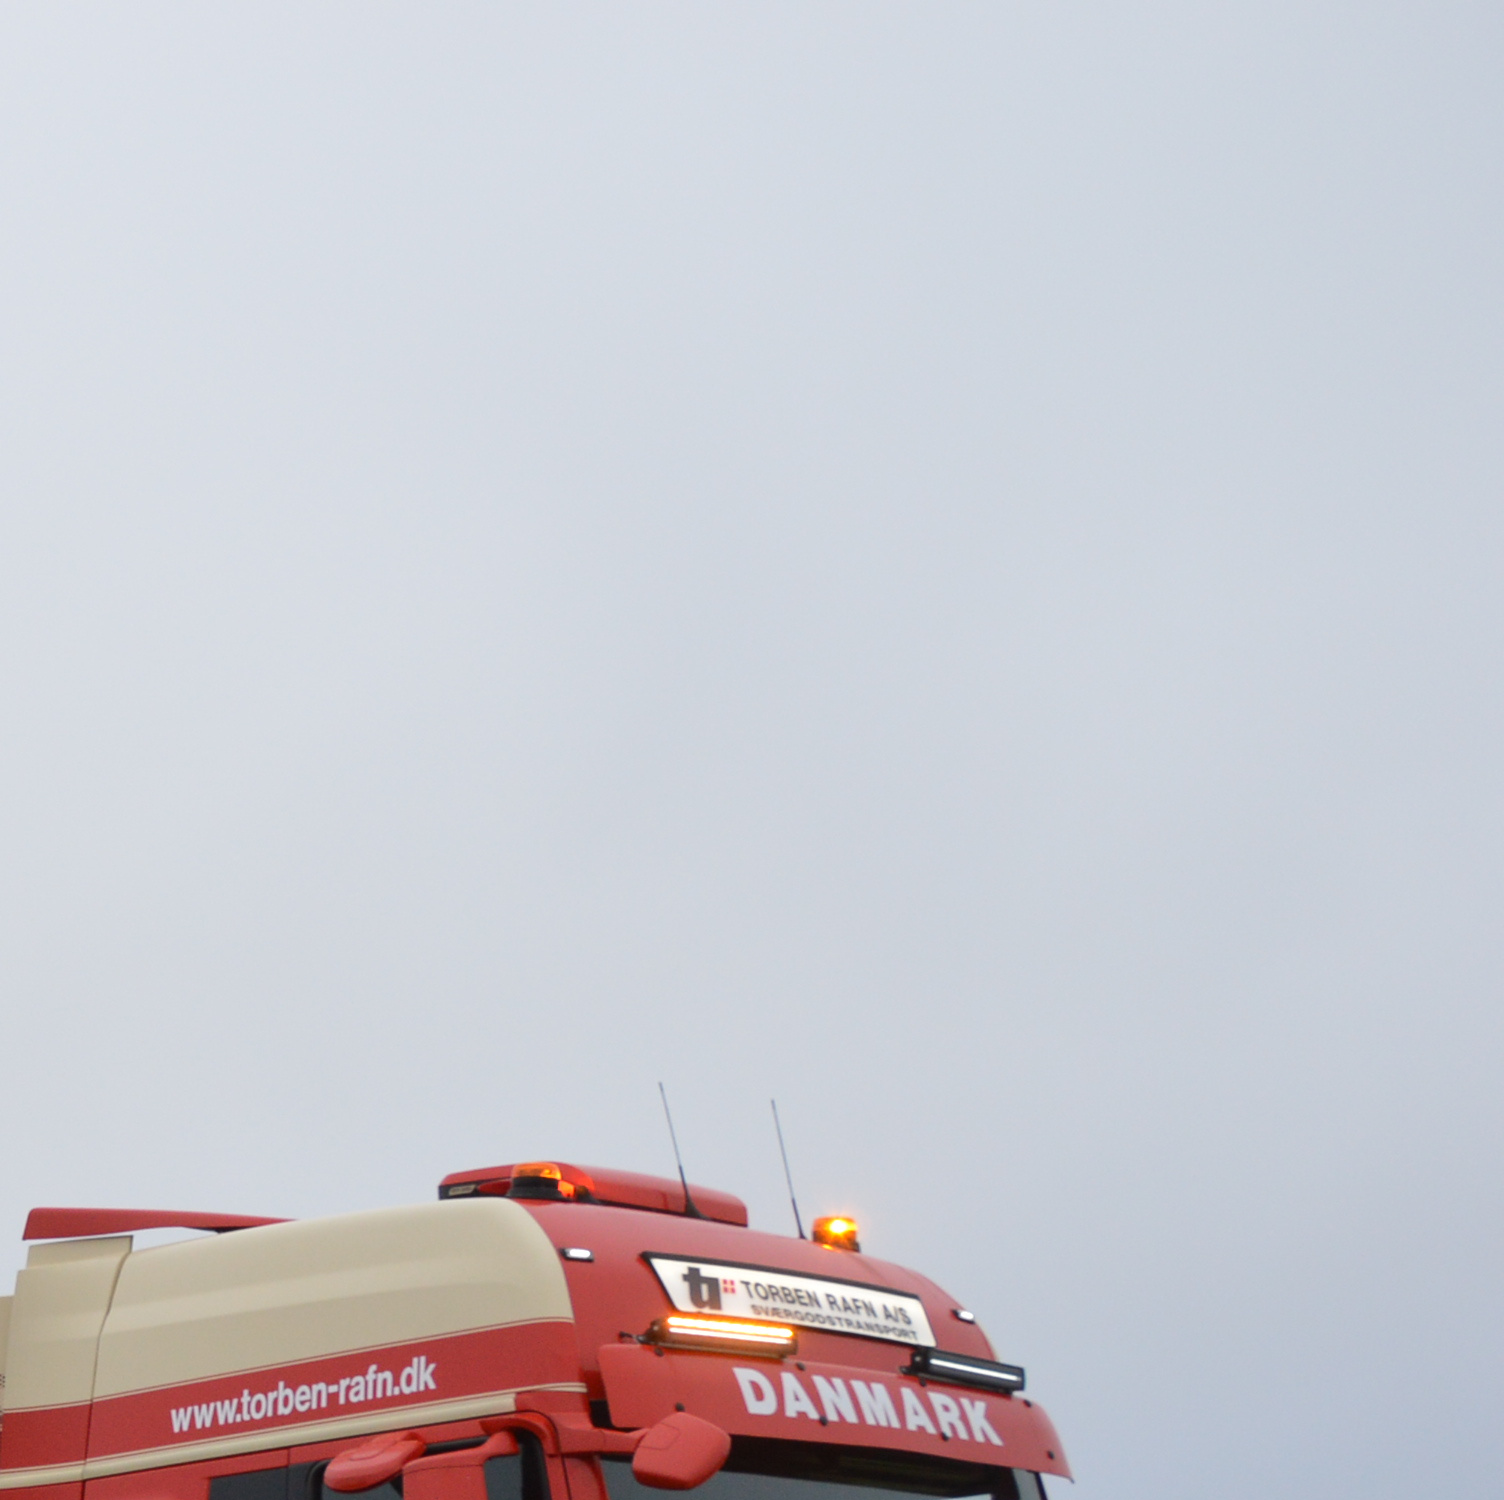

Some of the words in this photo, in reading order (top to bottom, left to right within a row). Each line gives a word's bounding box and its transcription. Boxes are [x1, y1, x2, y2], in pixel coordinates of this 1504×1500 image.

[741, 1280, 821, 1308] TORBEN
[827, 1293, 878, 1318] RAFN
[883, 1305, 912, 1326] A/S
[751, 1304, 918, 1341] SVÆRGODSTRANSPORT
[170, 1355, 436, 1433] www.torben-rafn.dk
[733, 1367, 1004, 1447] DANMARK
